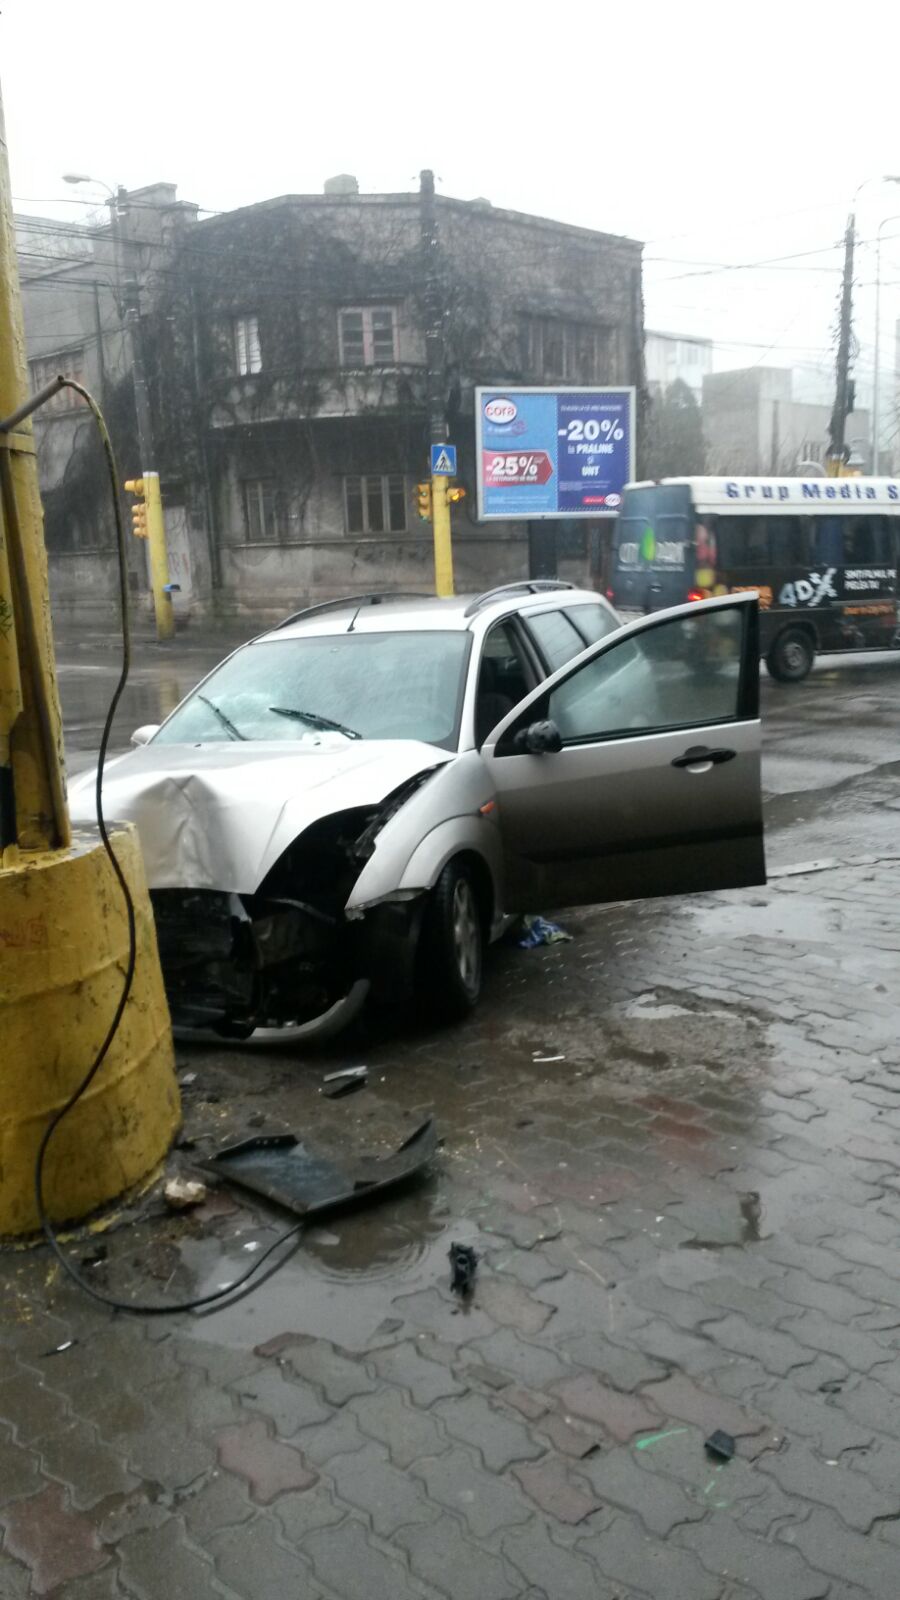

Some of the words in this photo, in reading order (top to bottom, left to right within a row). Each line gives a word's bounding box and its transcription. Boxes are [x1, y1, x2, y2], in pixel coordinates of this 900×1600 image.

[486, 406, 515, 416] cora
[557, 418, 624, 441] -20%
[576, 443, 614, 454] PRALINE
[486, 455, 538, 476] -25%
[725, 483, 789, 501] Grup
[801, 483, 876, 499] Media
[887, 484, 899, 499] S
